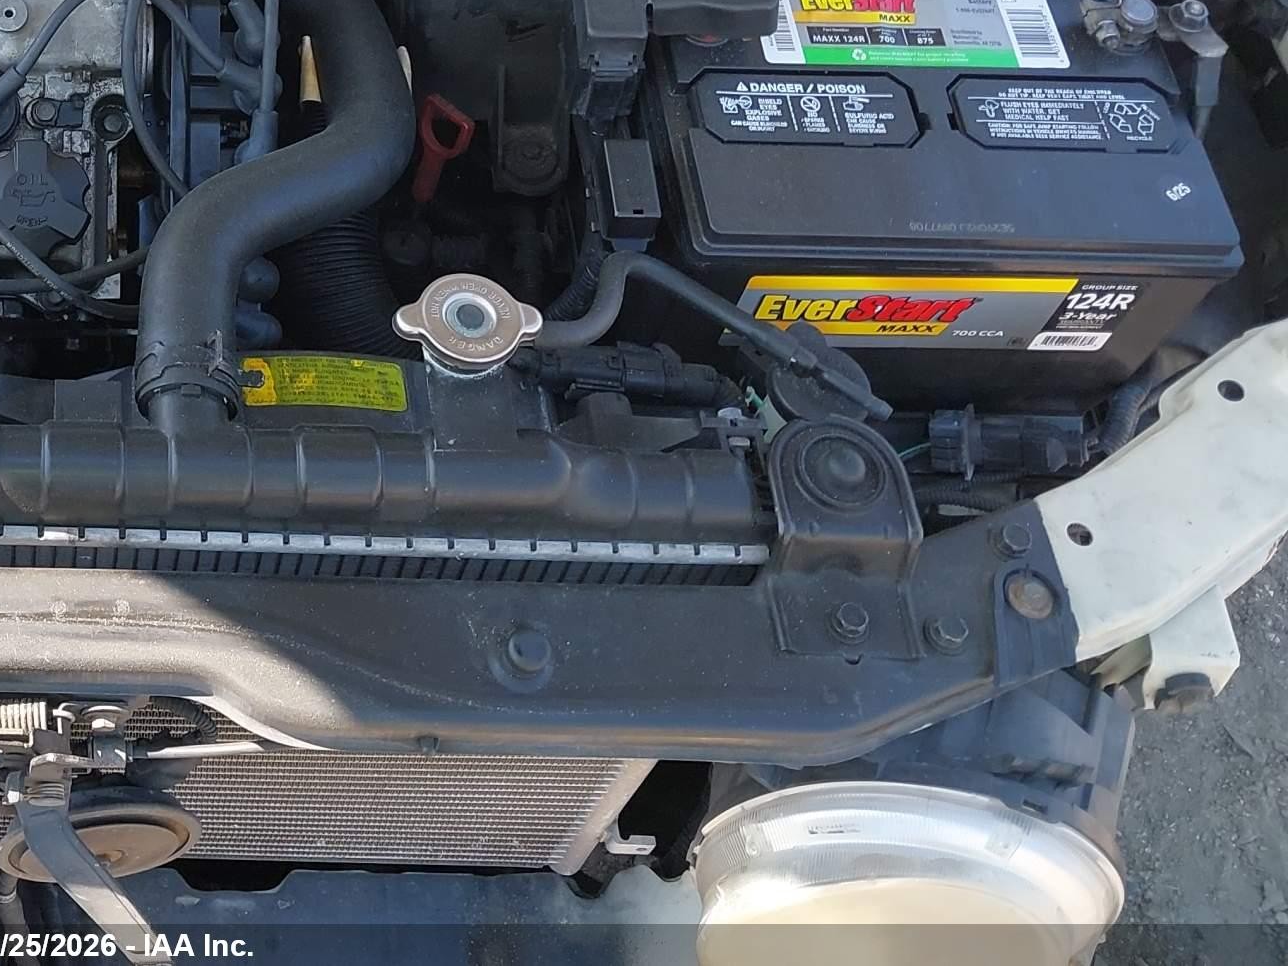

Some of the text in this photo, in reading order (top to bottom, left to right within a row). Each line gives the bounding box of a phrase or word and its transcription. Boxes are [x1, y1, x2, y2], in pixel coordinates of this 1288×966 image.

[878, 13, 911, 23] MAXX
[812, 34, 866, 44] MAXX 124R
[878, 35, 896, 44] 700
[917, 37, 934, 45] 875
[750, 83, 805, 93] DANGER
[817, 84, 866, 94] POISON
[16, 174, 49, 186] OIL
[1165, 182, 1192, 202] 6/25
[1066, 292, 1135, 311] 124R
[754, 294, 975, 323] EverStart
[1058, 311, 1117, 321] 3-Year
[876, 324, 938, 333] MAXX
[448, 336, 505, 352] DANGER
